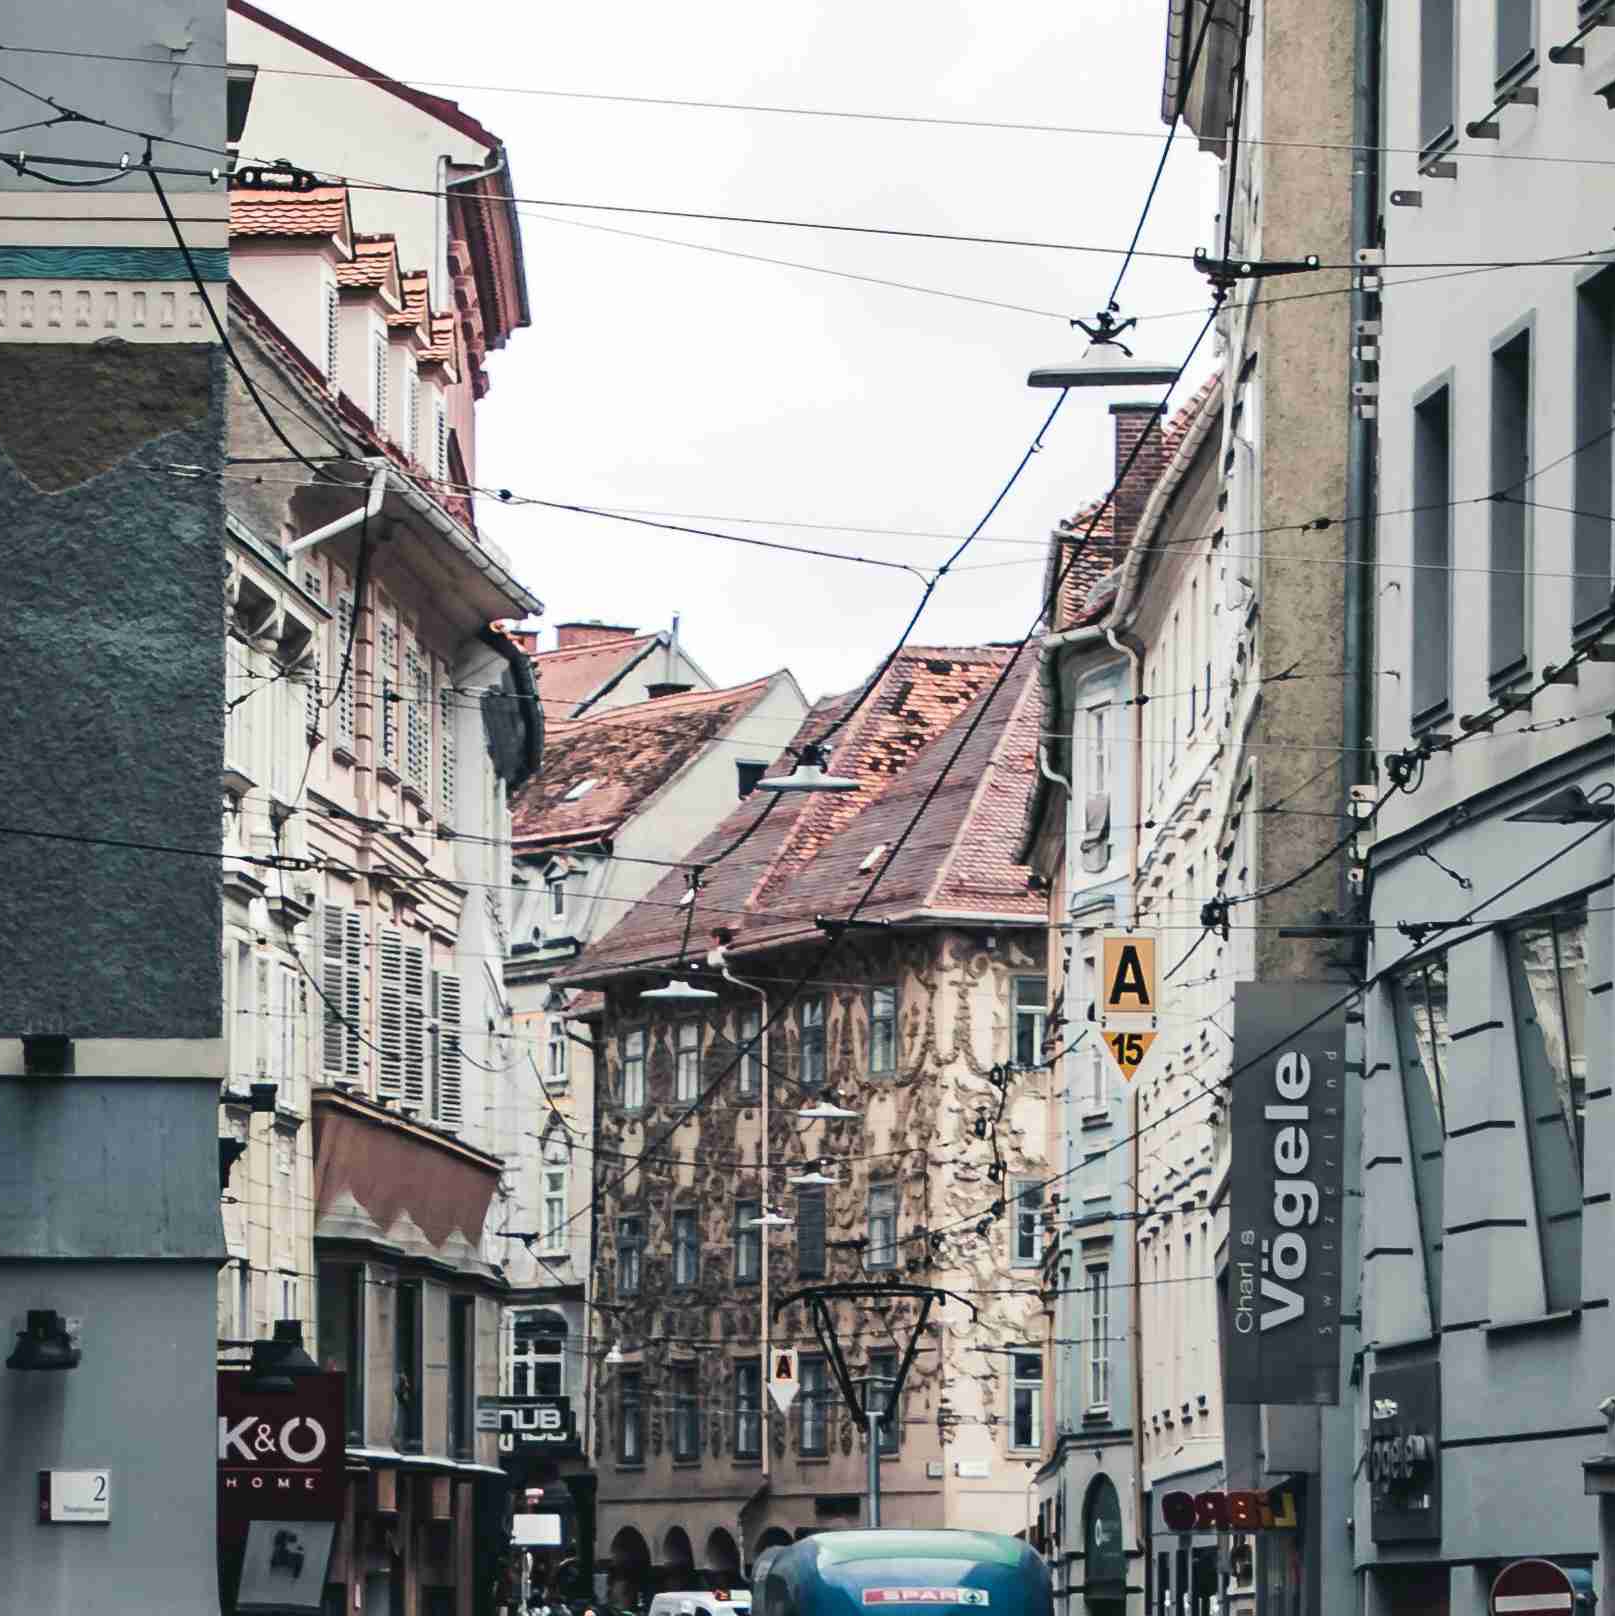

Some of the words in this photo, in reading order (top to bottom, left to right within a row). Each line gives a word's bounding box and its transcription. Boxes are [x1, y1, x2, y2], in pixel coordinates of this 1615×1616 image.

[1109, 945, 1150, 1005] A
[1112, 1032, 1144, 1067] 15
[1259, 1051, 1320, 1332] Vögele
[1318, 1050, 1337, 1336] Switzerland
[776, 1354, 793, 1379] A
[93, 1475, 106, 1501] 2
[226, 1477, 316, 1489] HOME
[882, 1588, 960, 1602] SPAR
